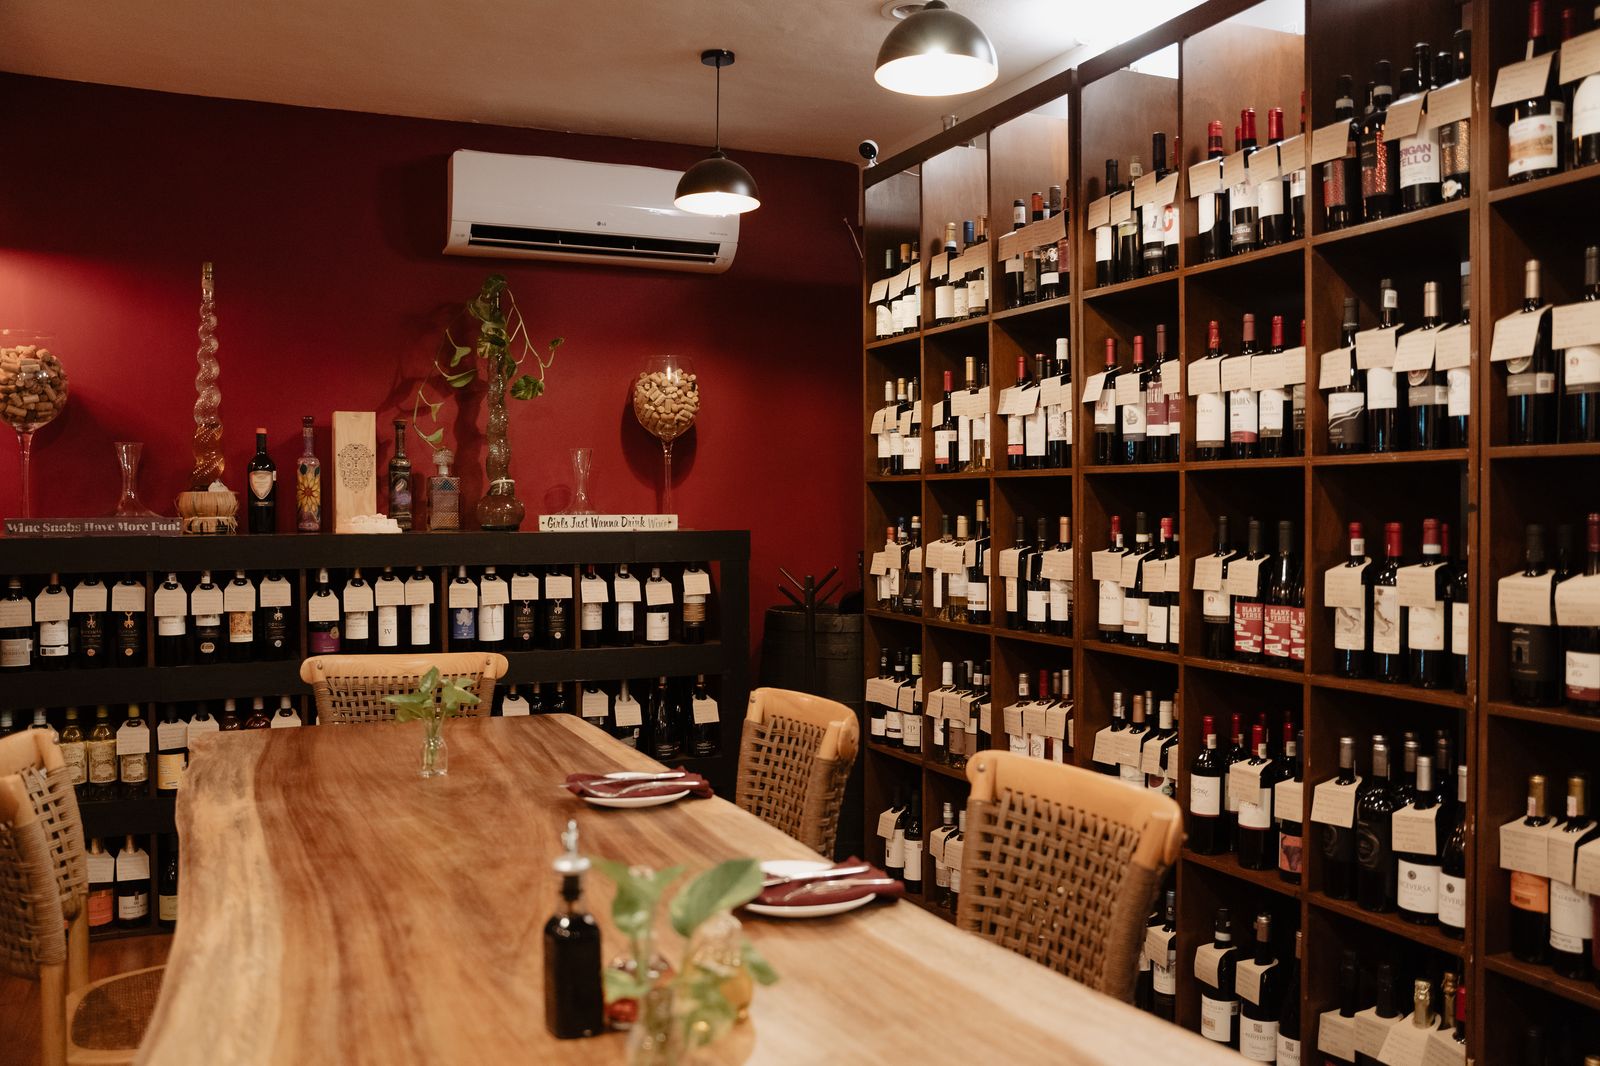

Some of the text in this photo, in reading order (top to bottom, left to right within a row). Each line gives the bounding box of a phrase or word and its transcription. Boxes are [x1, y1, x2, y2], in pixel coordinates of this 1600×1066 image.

[1400, 143, 1432, 158] RIGAN
[1400, 153, 1432, 167] ELLO
[7, 521, 181, 533] Wine Snobs Have More Fun!
[547, 516, 568, 529] Girls
[571, 516, 588, 529] Just
[591, 516, 619, 529] Wanna
[621, 516, 646, 528] Drink
[1242, 612, 1263, 620] VERSE
[1271, 615, 1290, 623] VERSE
